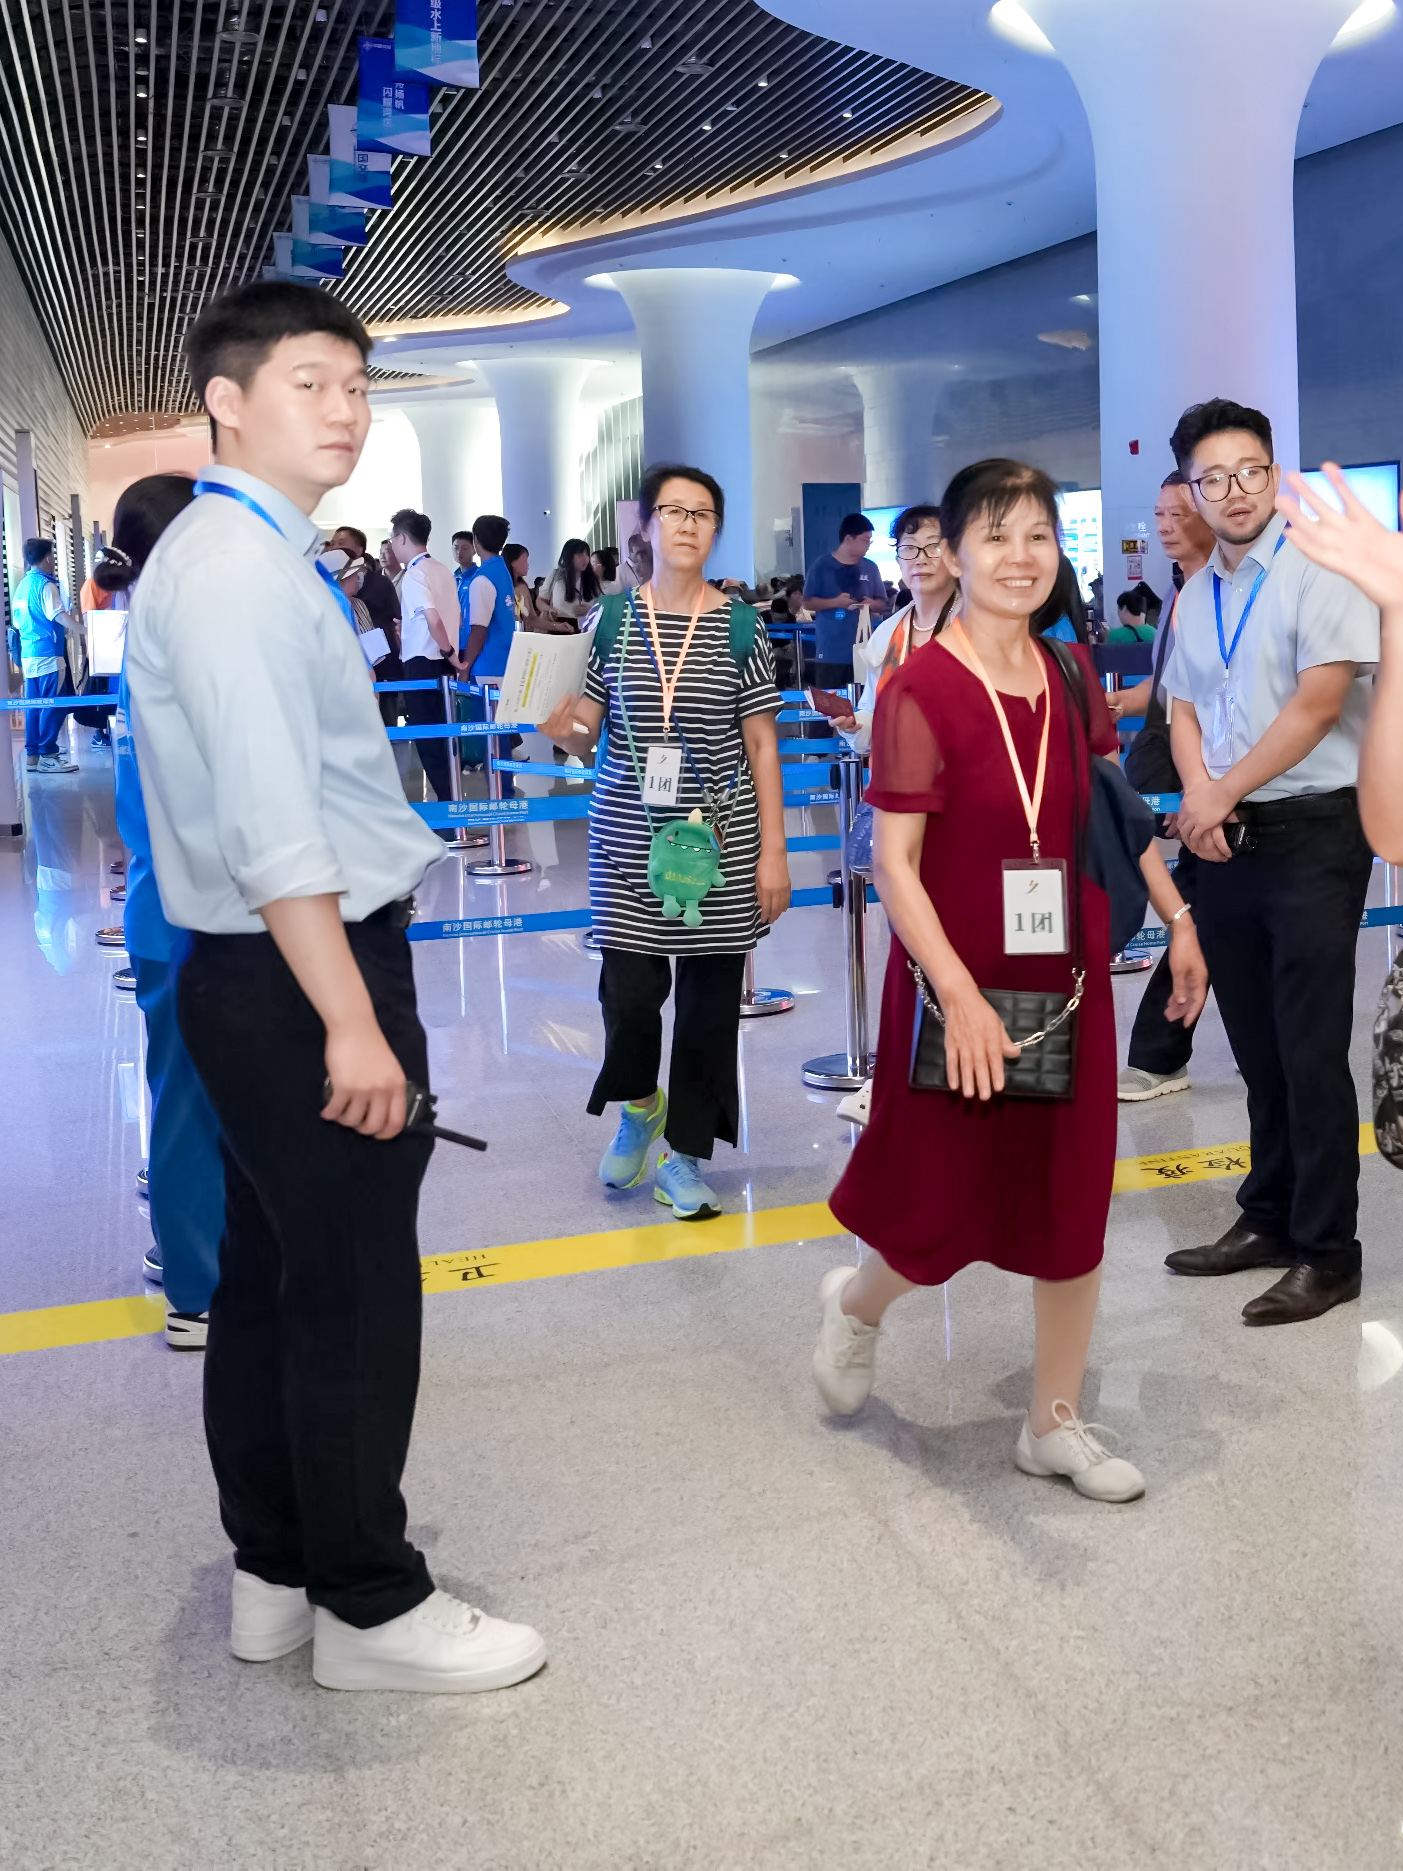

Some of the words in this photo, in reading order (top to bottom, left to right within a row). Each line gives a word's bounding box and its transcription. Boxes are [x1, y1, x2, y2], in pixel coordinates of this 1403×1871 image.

[448, 800, 529, 813] 南沙国际邮轮母港
[442, 917, 523, 932] 南沙国际邮轮母港
[1014, 911, 1053, 934] 1团
